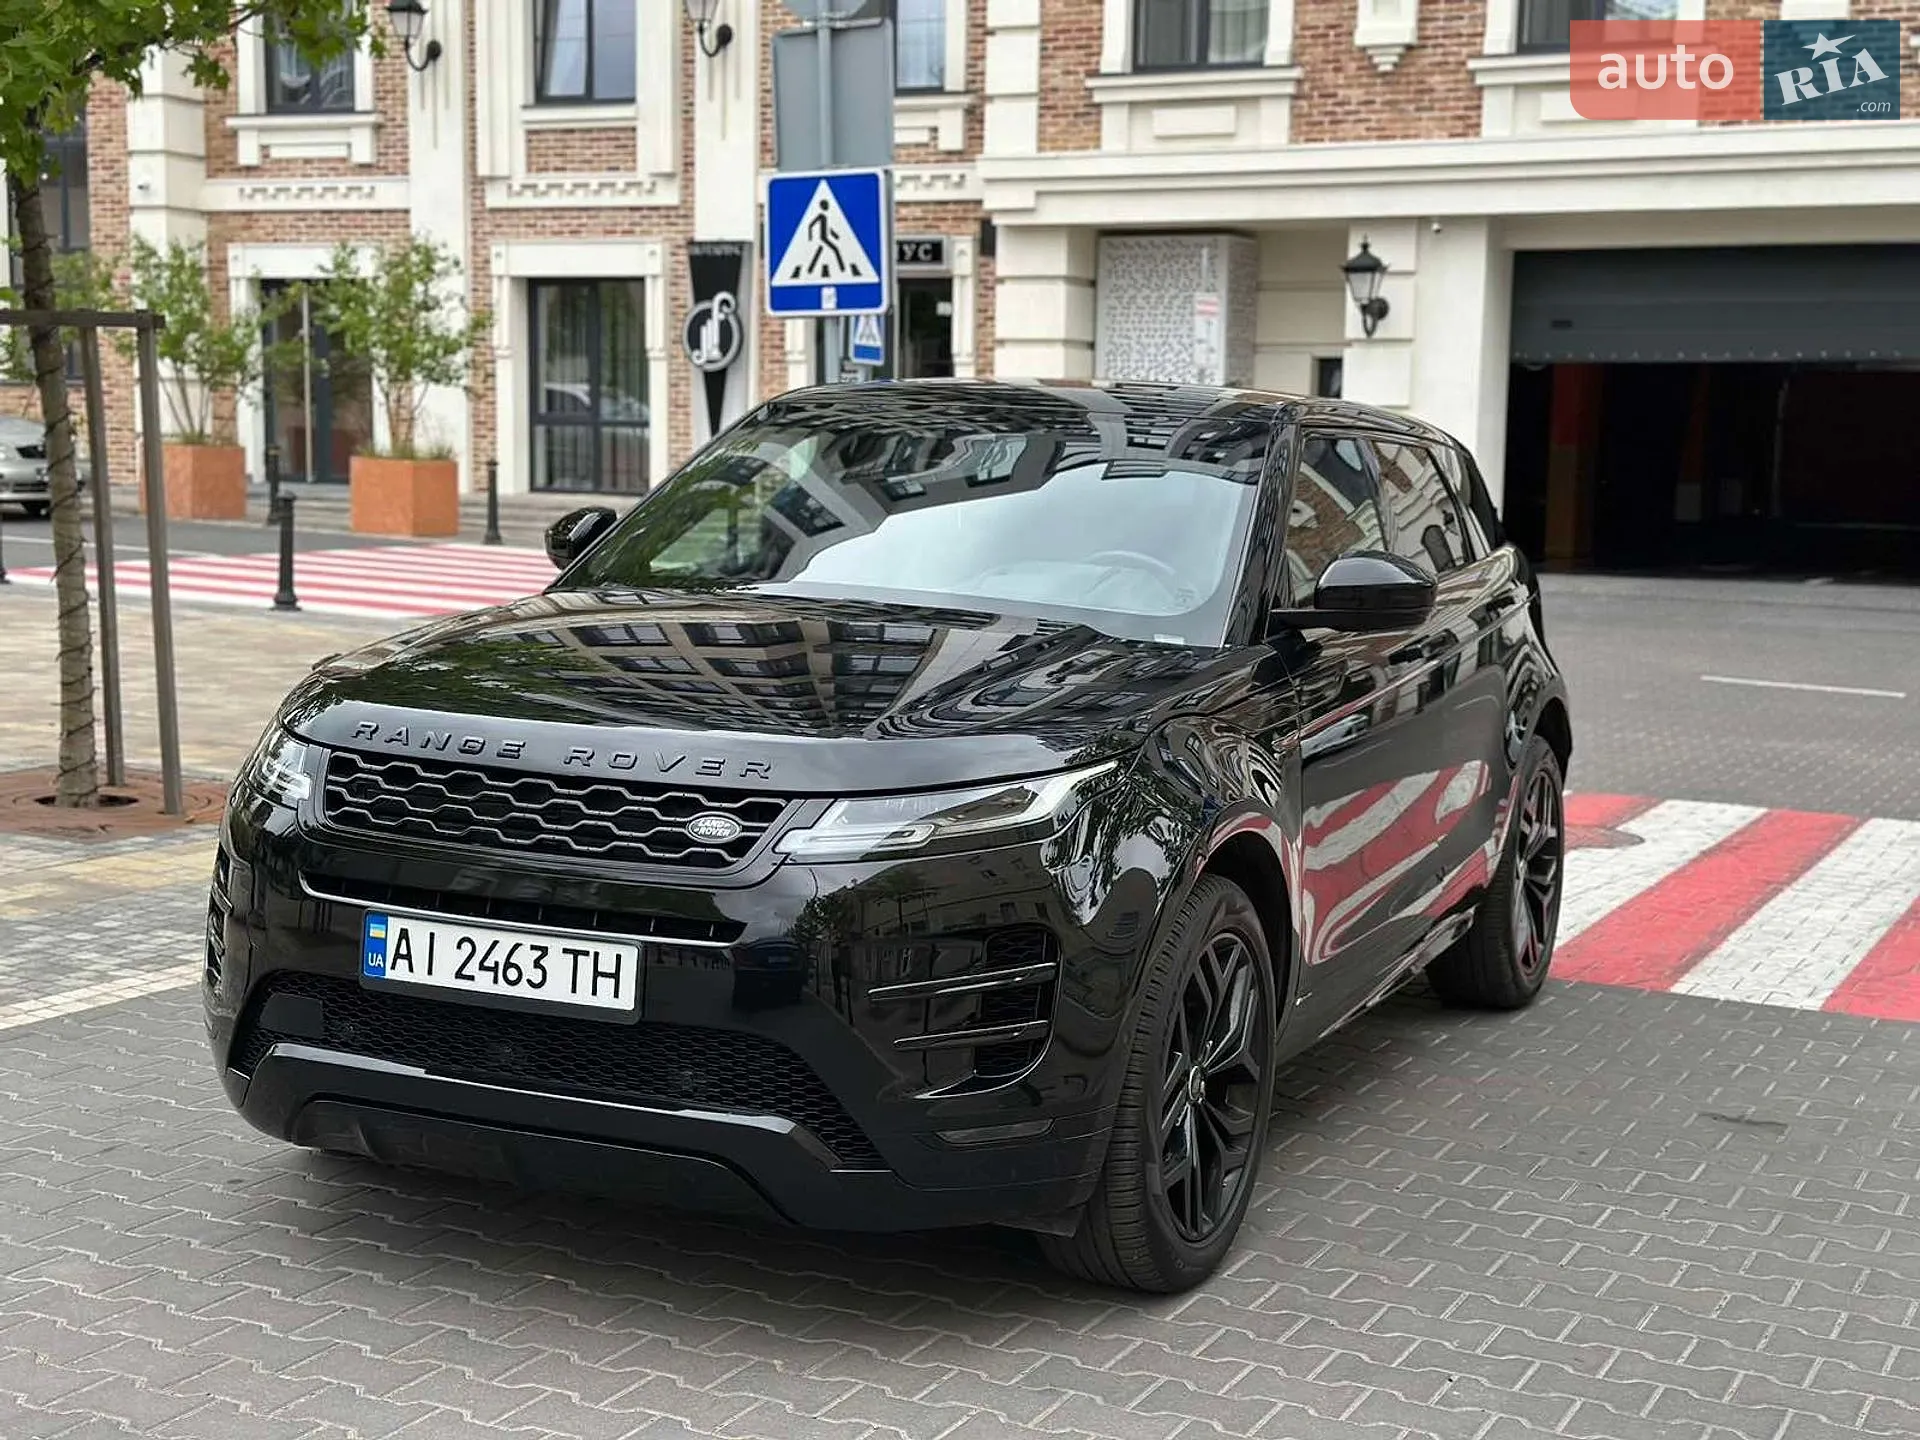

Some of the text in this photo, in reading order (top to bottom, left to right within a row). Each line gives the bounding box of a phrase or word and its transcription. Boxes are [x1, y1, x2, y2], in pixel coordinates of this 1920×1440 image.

[351, 721, 771, 780] RANGE ROVER
[368, 952, 384, 967] UA
[390, 927, 622, 999] AI 2463 TH
